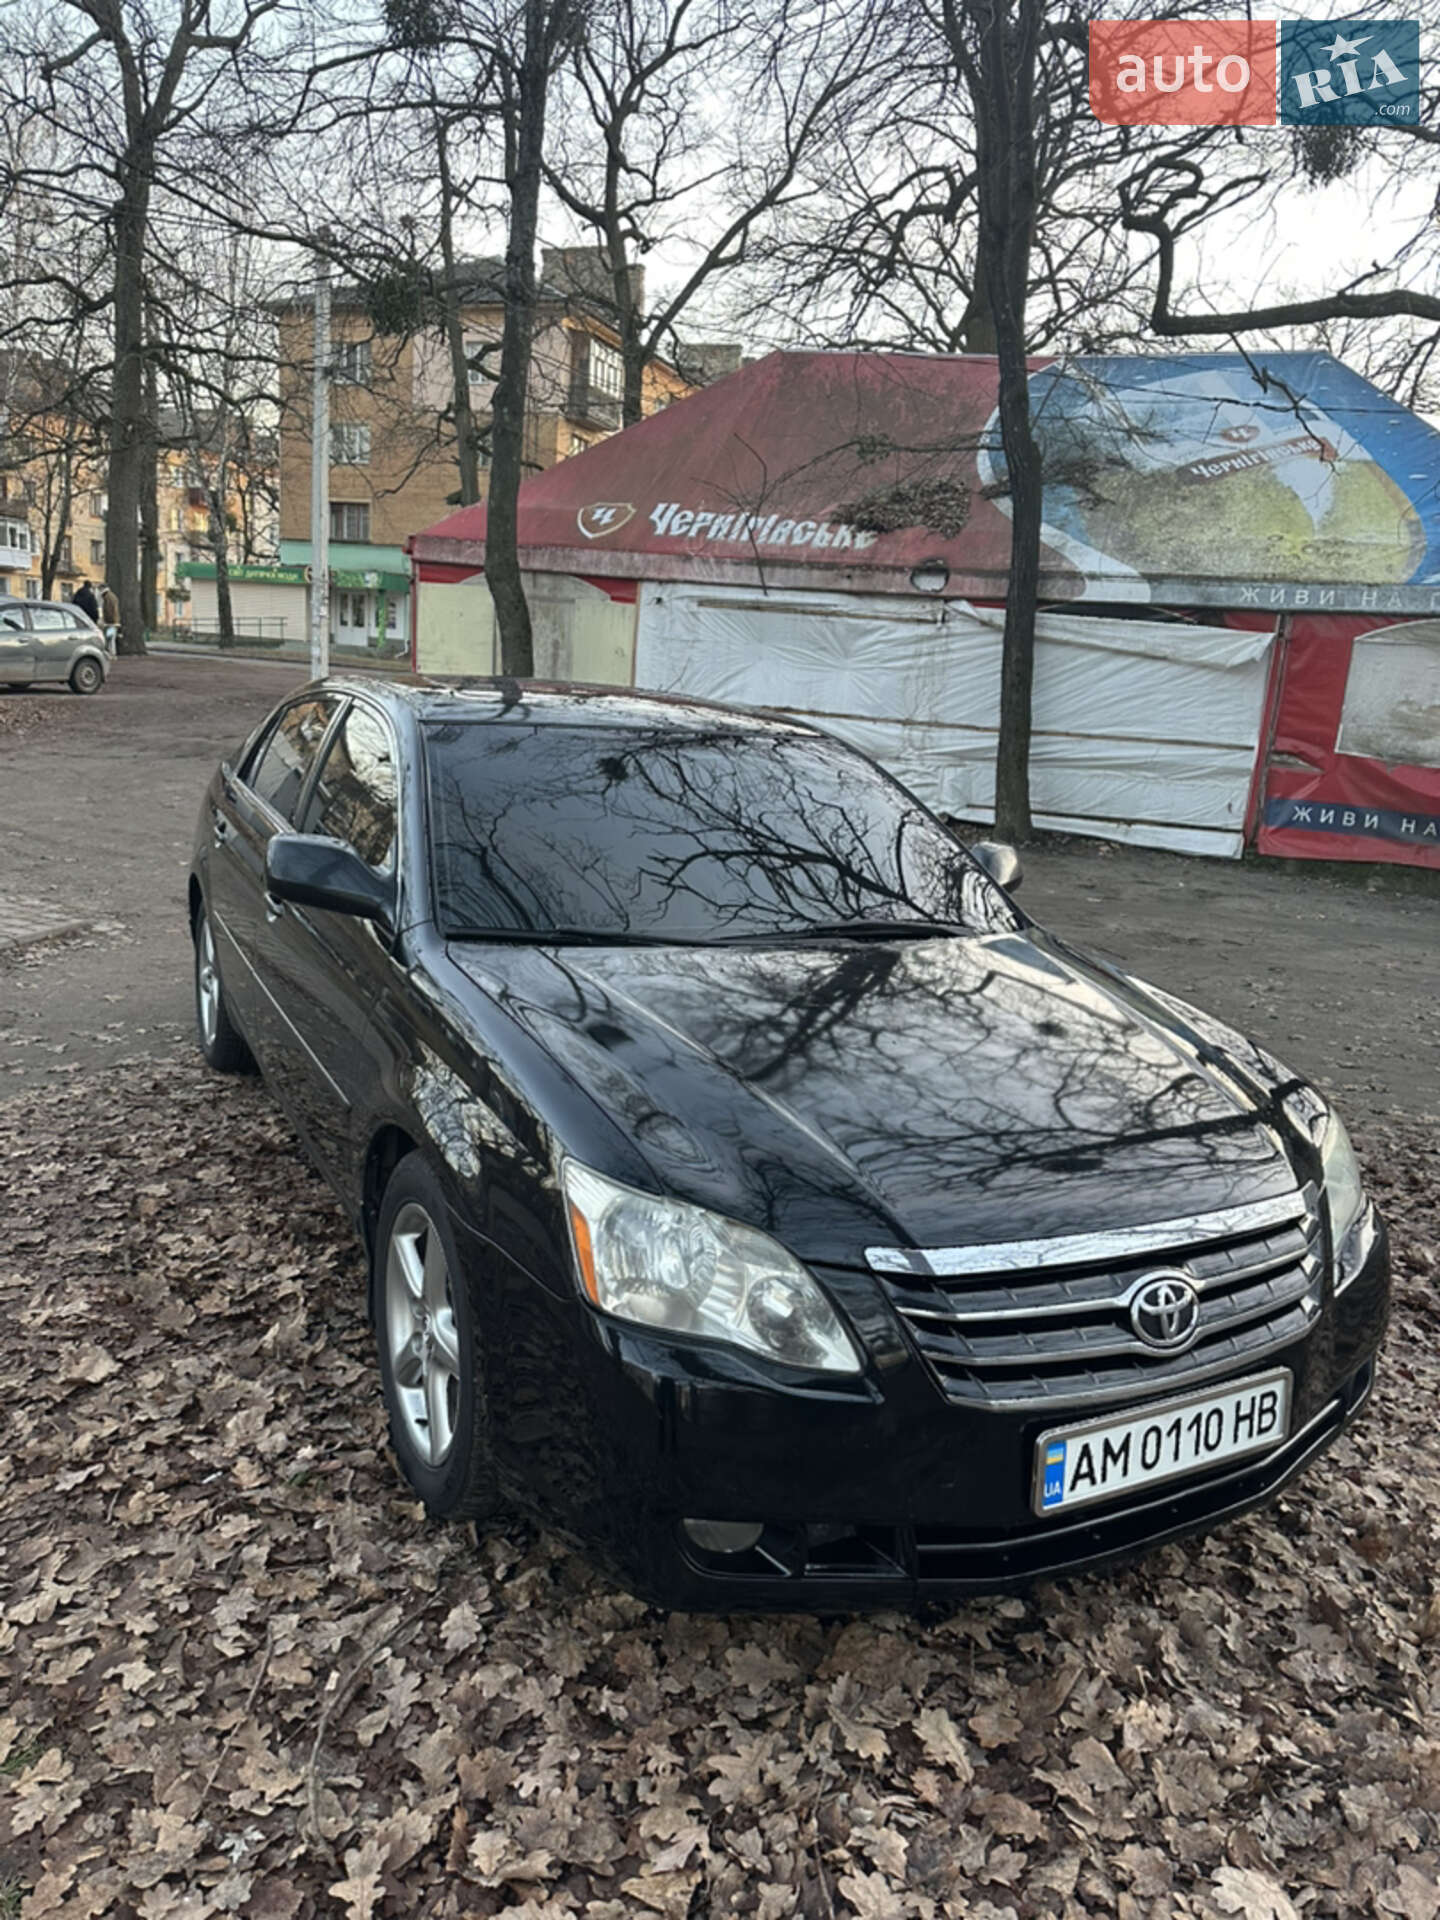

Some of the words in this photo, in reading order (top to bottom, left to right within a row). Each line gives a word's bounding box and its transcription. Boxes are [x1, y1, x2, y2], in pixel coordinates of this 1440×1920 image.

[1190, 438, 1322, 479] Чернігівське
[1239, 587, 1336, 606] ЖИВИ
[1361, 590, 1403, 609] НА
[1292, 806, 1380, 830] ЖИВИ
[1400, 818, 1438, 838] НА
[1043, 1480, 1062, 1498] UA
